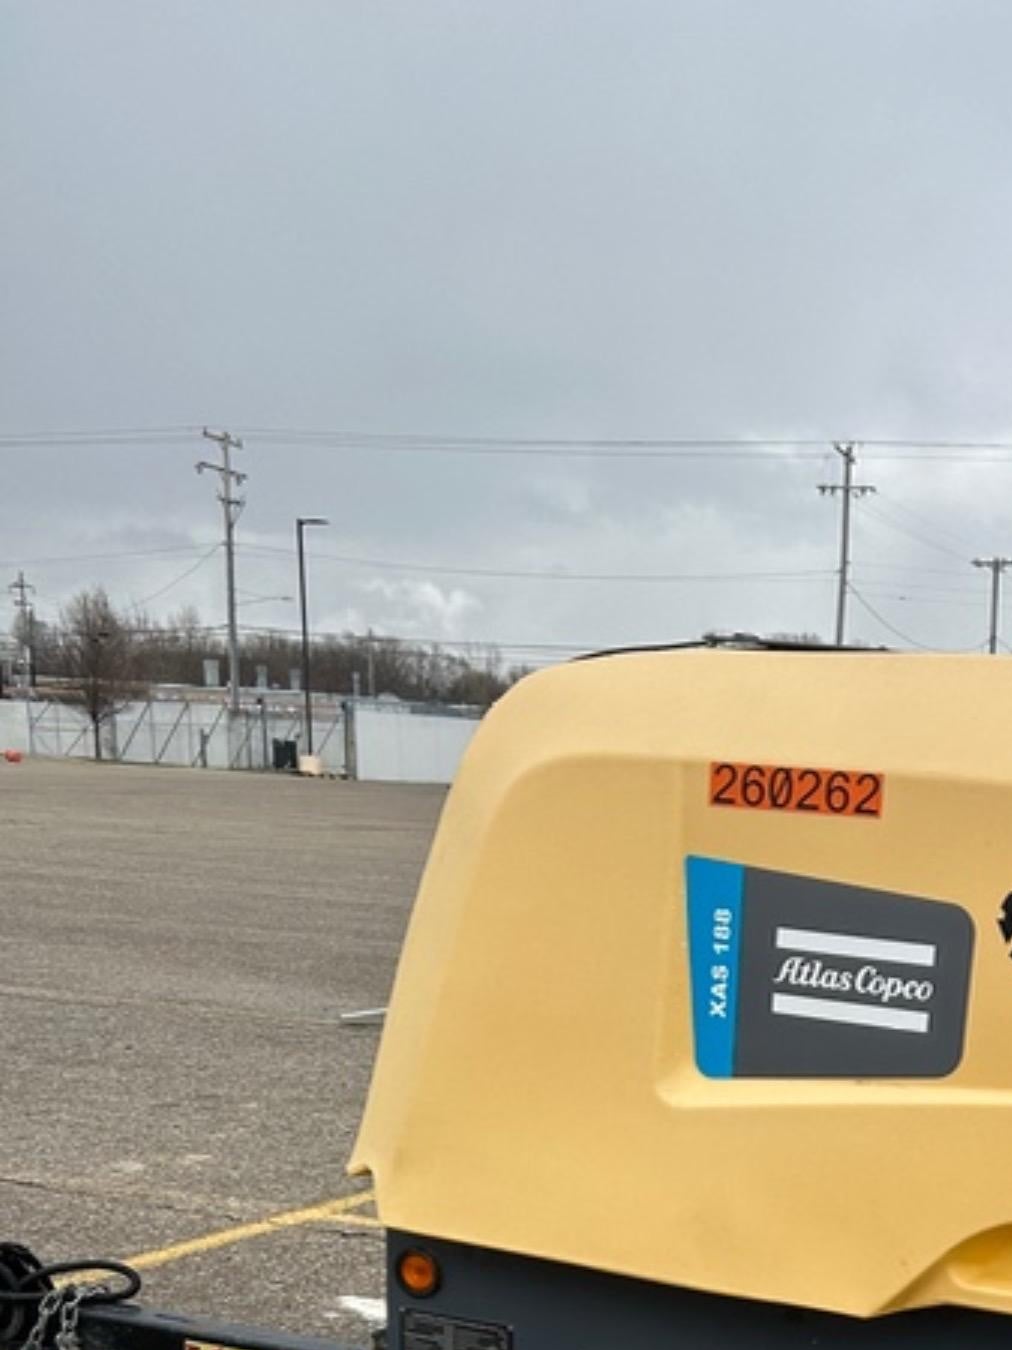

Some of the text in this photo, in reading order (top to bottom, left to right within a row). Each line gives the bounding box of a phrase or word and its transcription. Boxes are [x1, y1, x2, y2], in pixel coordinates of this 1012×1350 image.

[711, 764, 880, 815] 260262
[710, 965, 730, 1018] XAS
[774, 956, 934, 1002] Atlas Copco
